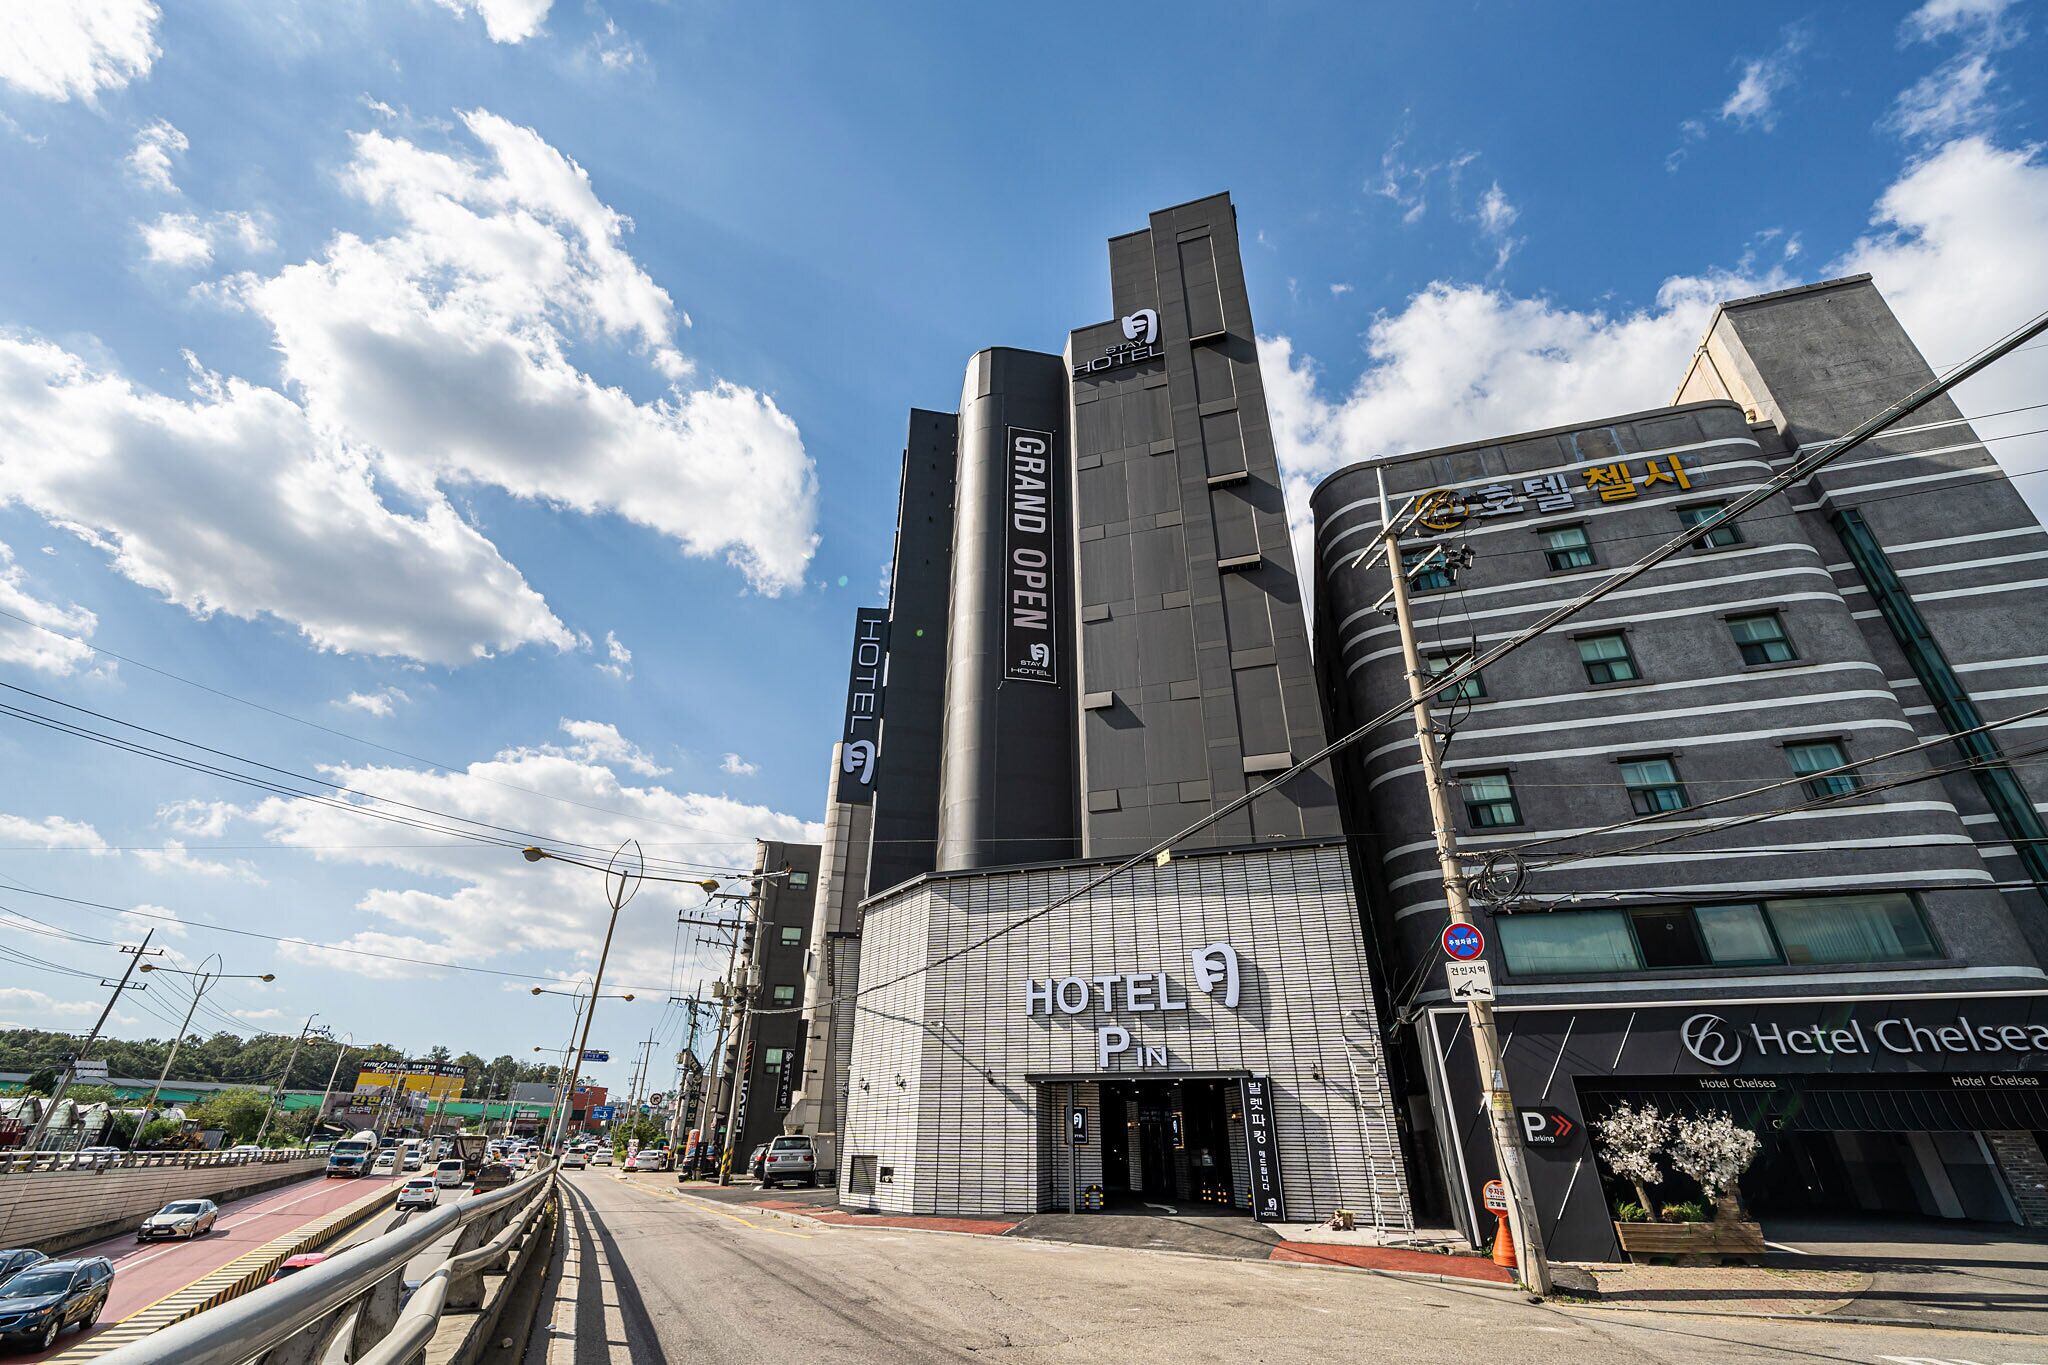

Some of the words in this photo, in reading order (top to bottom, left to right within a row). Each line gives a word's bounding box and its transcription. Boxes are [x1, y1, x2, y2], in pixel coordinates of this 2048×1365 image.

[1072, 346, 1165, 376] HOTEL
[1105, 339, 1144, 354] STAY
[1014, 436, 1046, 534] GRAND
[1582, 454, 1692, 504] 첼시
[1013, 548, 1048, 630] OPEN
[852, 619, 882, 734] HOTEL
[1010, 667, 1051, 677] HOTEL
[1020, 659, 1041, 667] STAY
[1448, 937, 1478, 946] 주정차금지
[1450, 965, 1486, 976] 견인지역
[1025, 972, 1187, 1016] HOTEL
[1874, 1016, 2048, 1053] Chelsea
[1699, 1078, 1730, 1089] Hotel
[1733, 1078, 1777, 1088] Chelsea
[1951, 1075, 1986, 1087] Hotel
[1989, 1075, 2040, 1086] Chelsea
[1247, 1082, 1267, 1144] 발렛파킹
